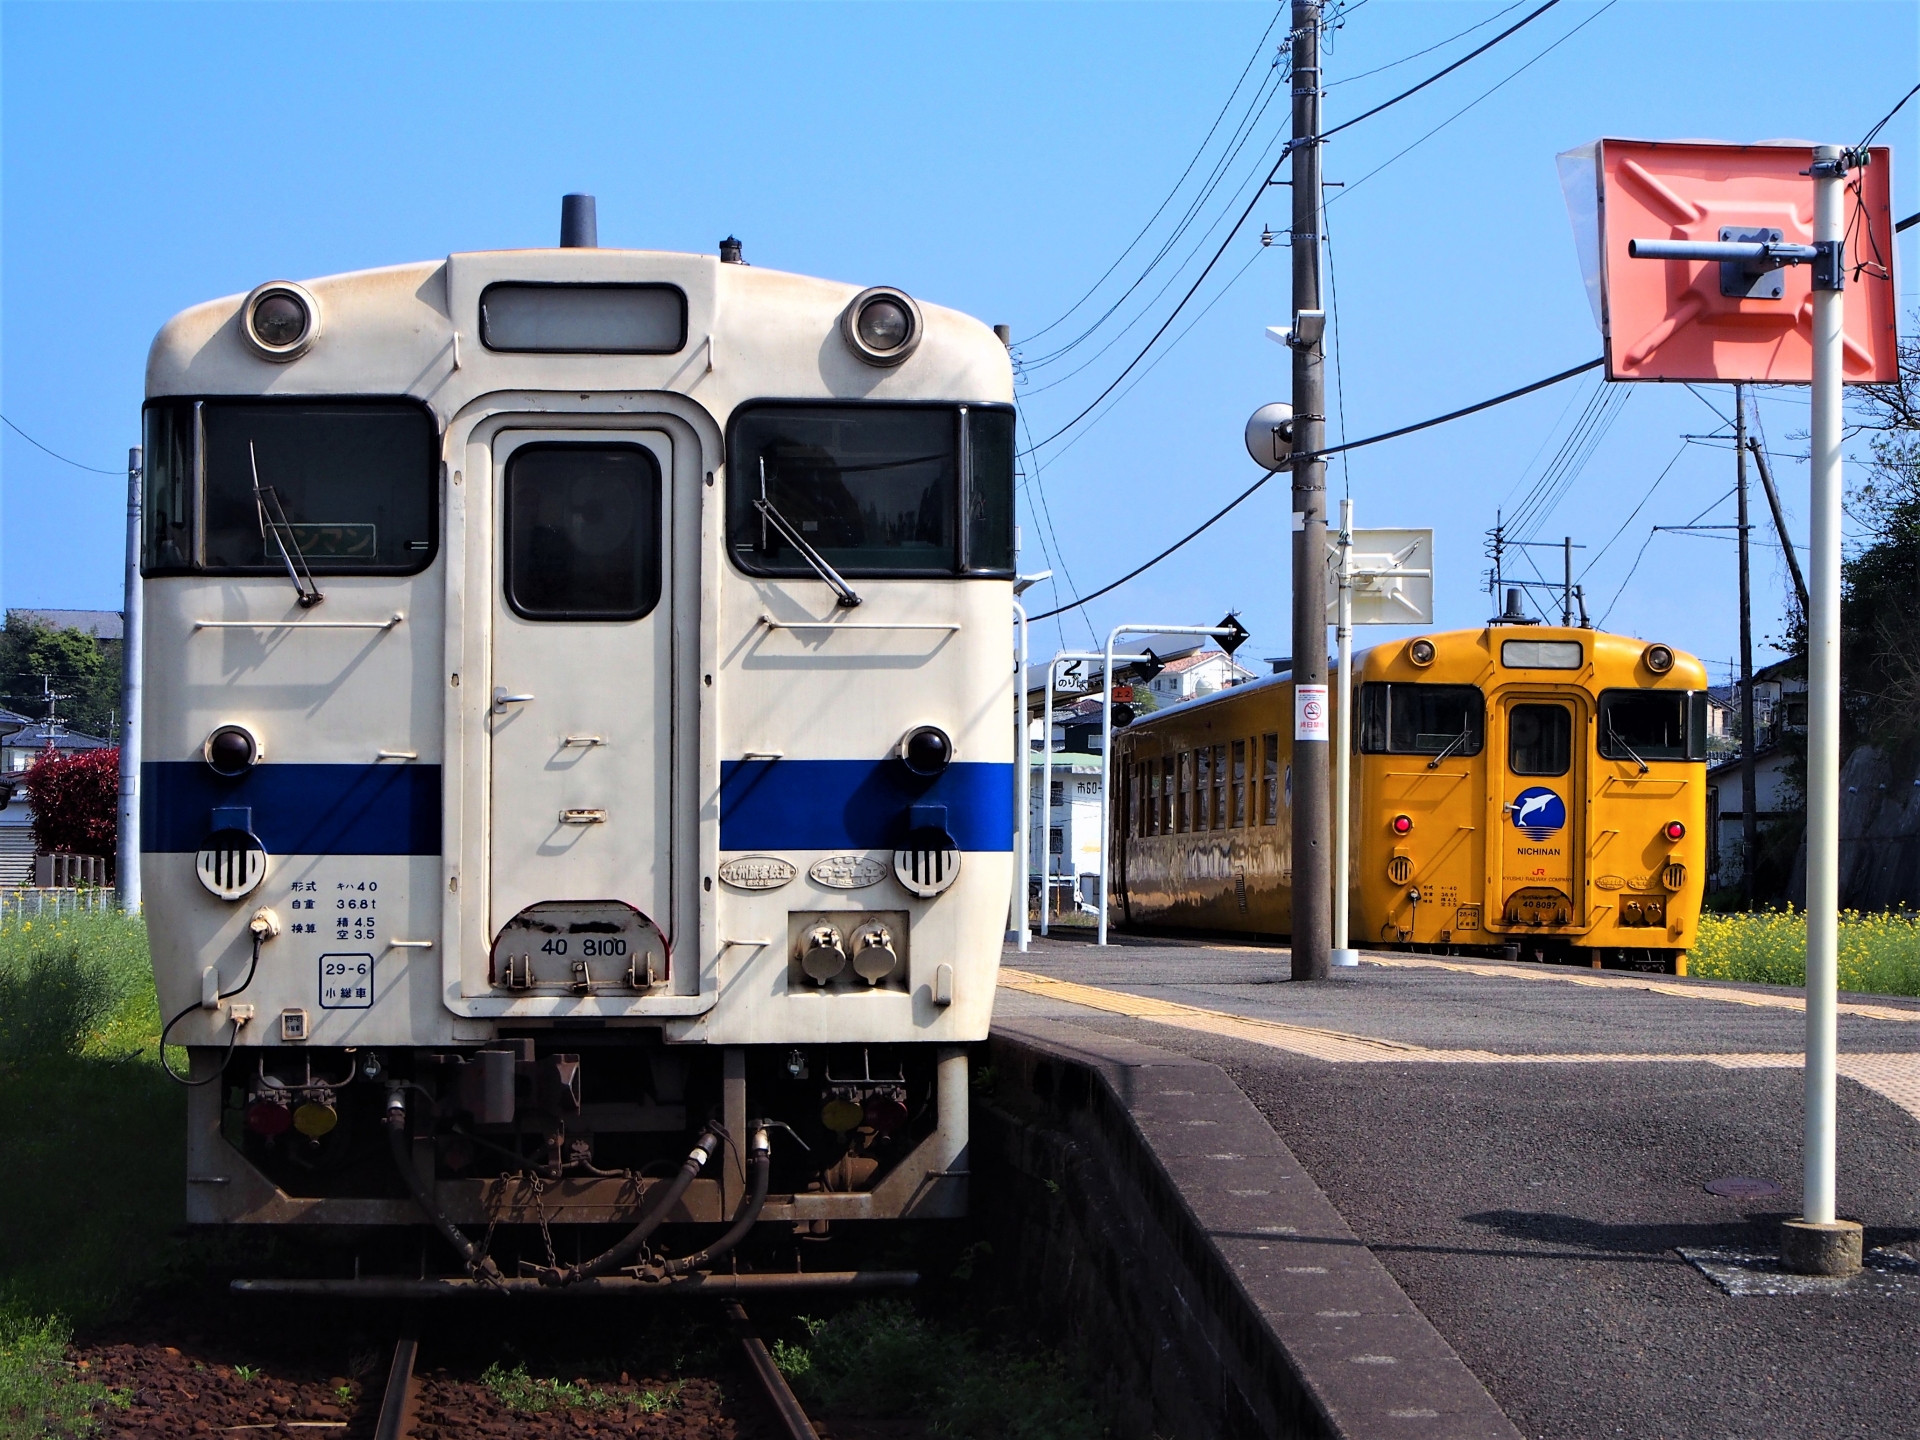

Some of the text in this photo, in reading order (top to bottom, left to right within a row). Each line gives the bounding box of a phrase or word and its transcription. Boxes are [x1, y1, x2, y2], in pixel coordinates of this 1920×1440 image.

[1063, 659, 1081, 676] 2
[1517, 847, 1561, 856] NICHINAN
[727, 864, 791, 880] 九州旅客鉄道
[1532, 868, 1545, 876] JR
[291, 880, 317, 892] 形式
[292, 899, 316, 910] 自重
[1535, 901, 1557, 910] 8097
[354, 917, 375, 928] 4.5
[336, 929, 375, 940] 空 3.5
[541, 938, 627, 956] 40 8100
[325, 963, 367, 975] 29-6
[325, 987, 367, 998] 小総車
